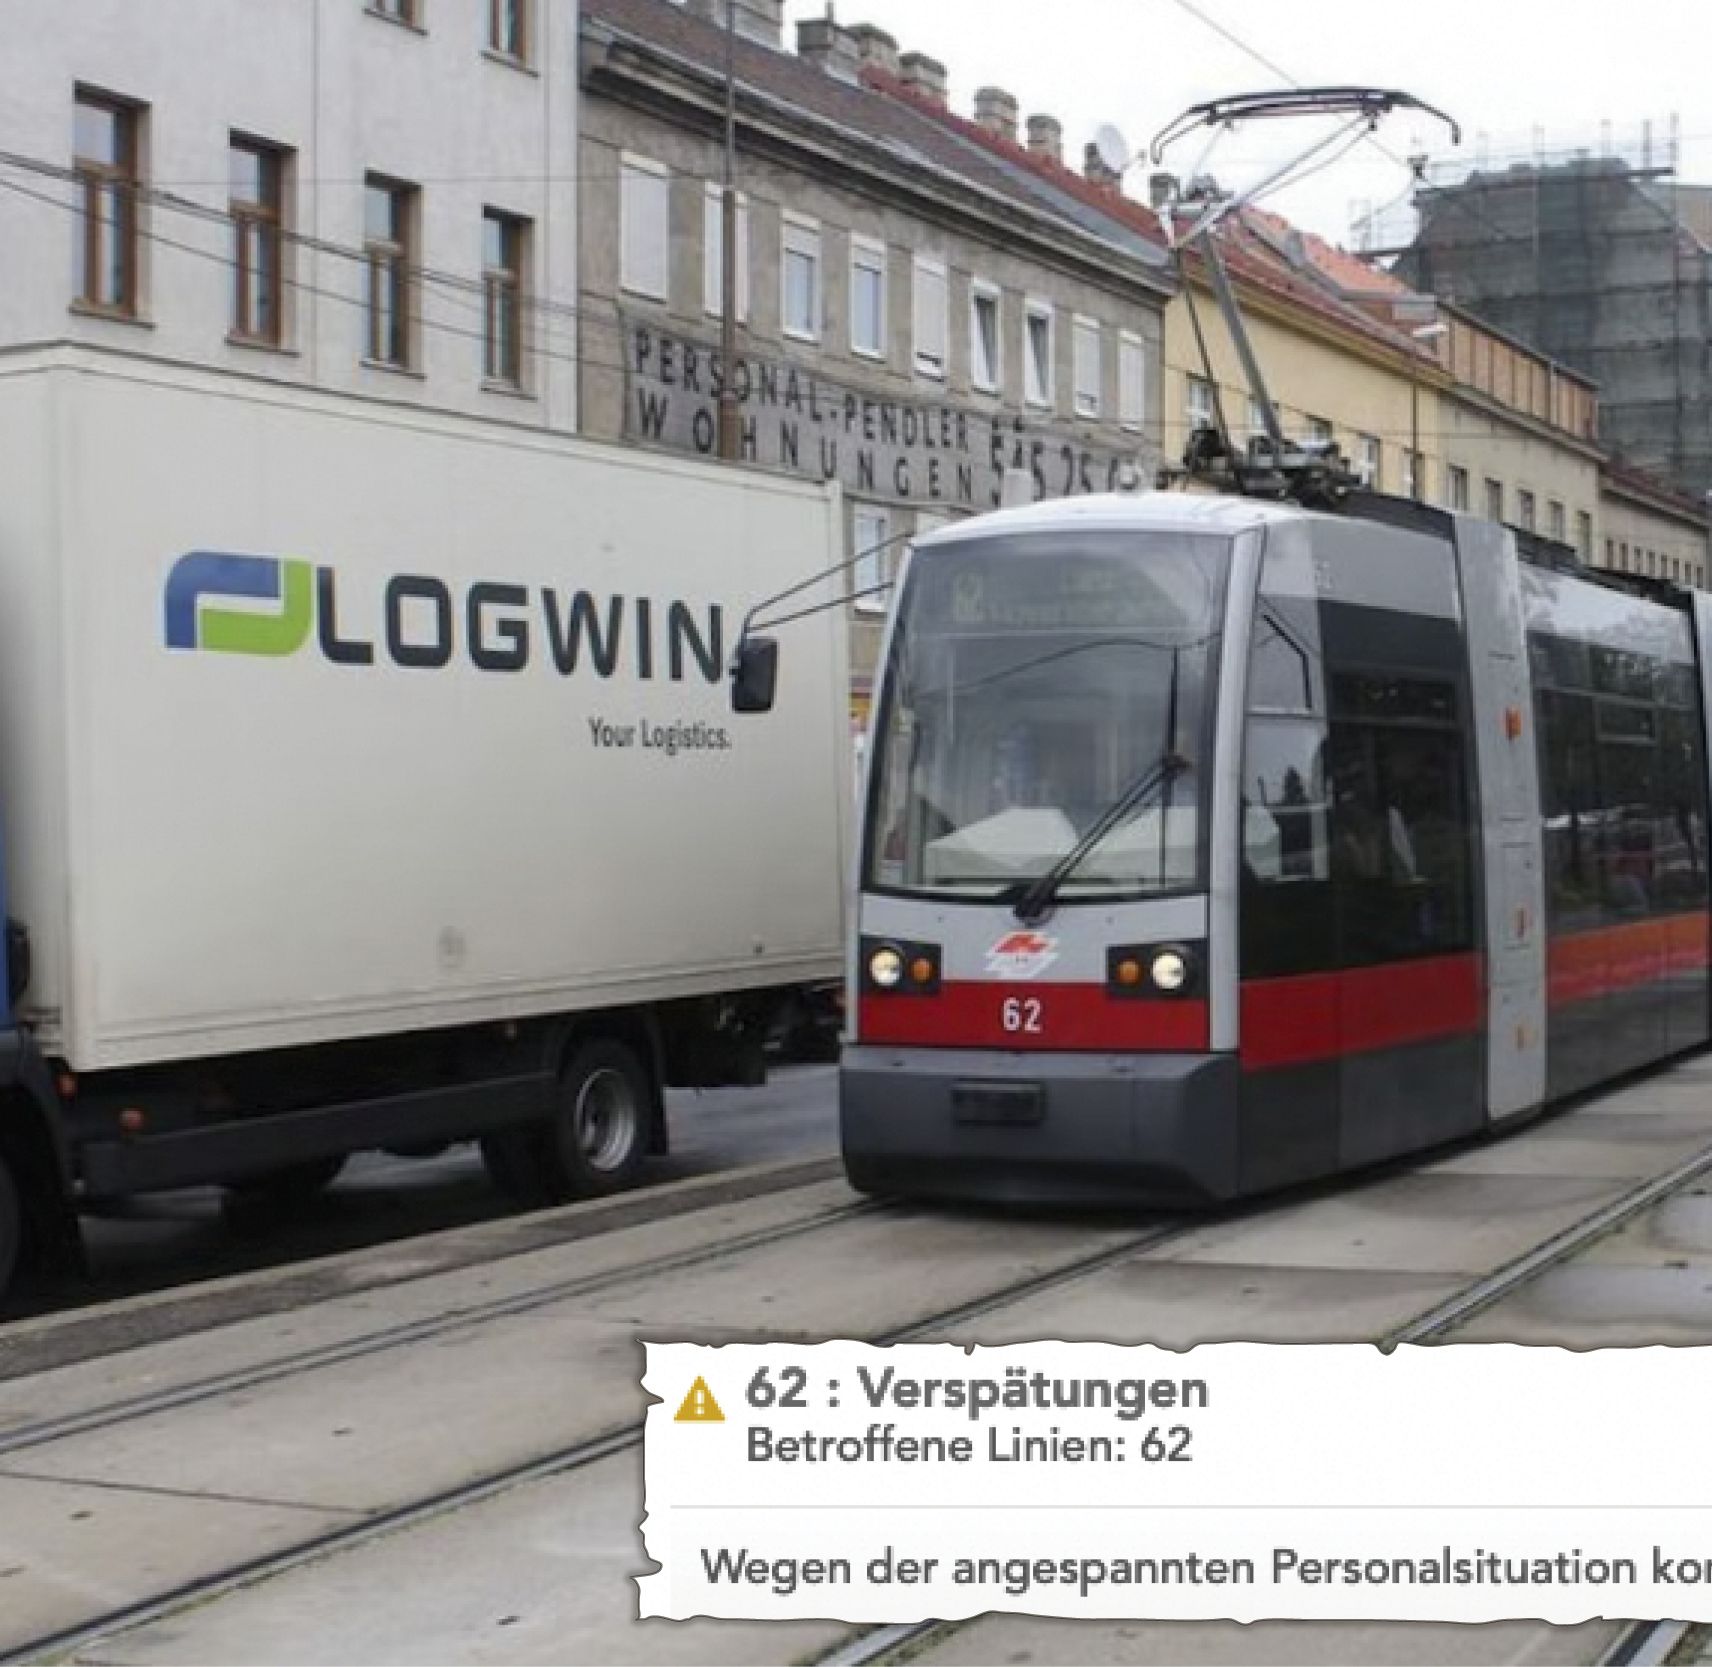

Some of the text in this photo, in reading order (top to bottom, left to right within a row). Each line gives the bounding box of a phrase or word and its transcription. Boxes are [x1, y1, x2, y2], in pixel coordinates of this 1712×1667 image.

[636, 329, 968, 454] PERSONAL-PENDLER
[316, 566, 724, 684] LOGWIN
[589, 717, 733, 757] Your Logistics.
[1003, 997, 1041, 1032] 62
